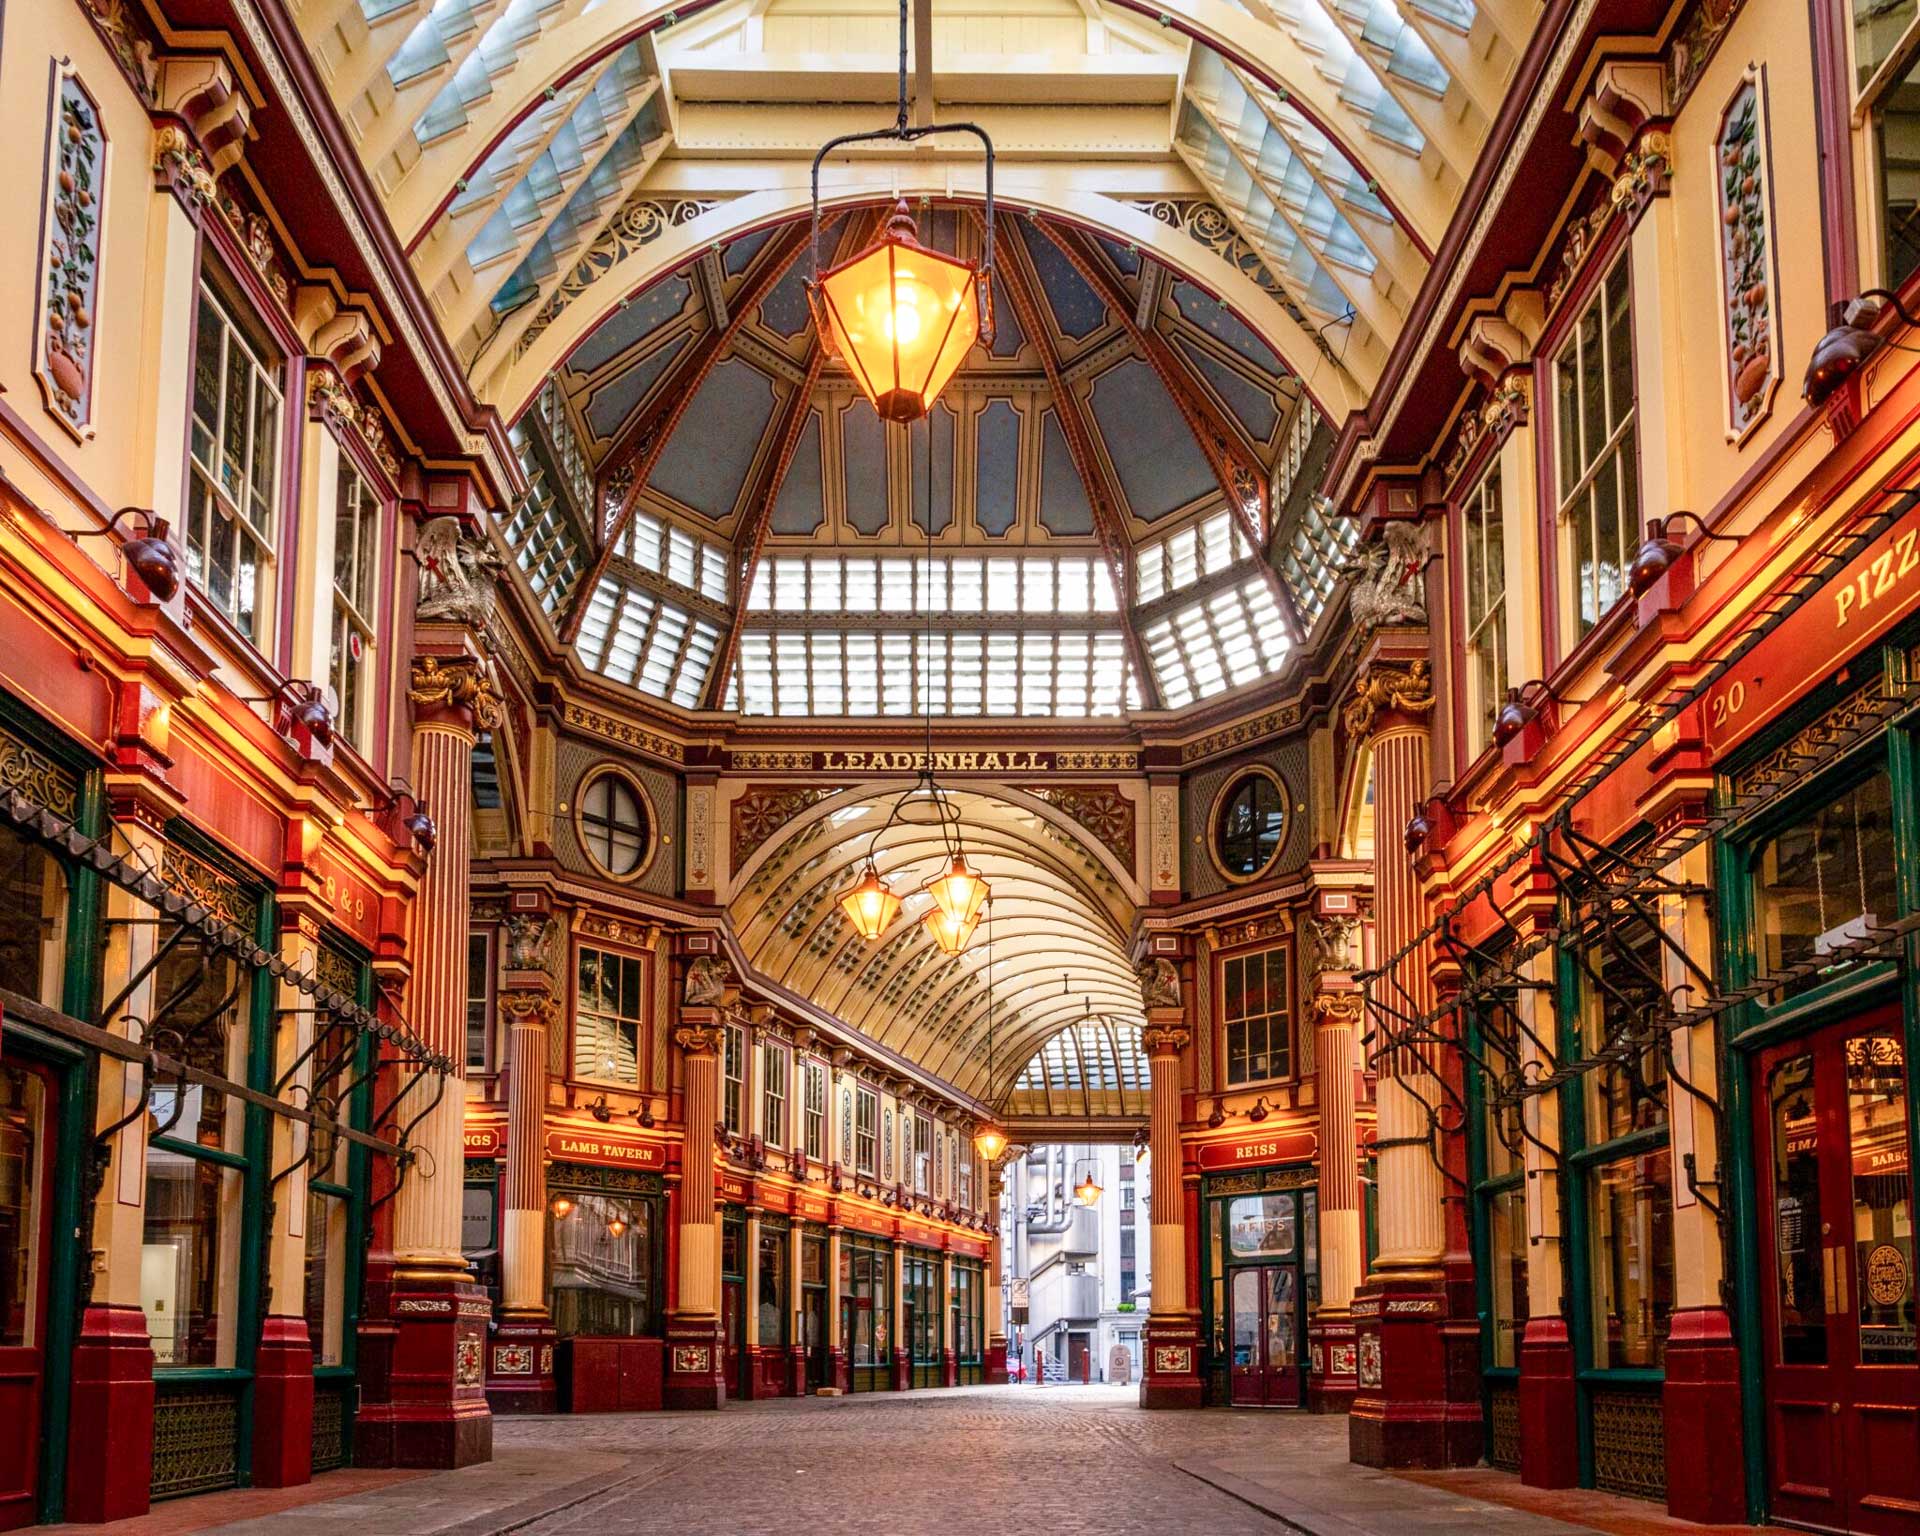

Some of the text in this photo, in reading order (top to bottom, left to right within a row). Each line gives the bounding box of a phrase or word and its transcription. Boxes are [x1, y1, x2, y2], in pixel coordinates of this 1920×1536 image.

[1712, 680, 1746, 729] 20
[823, 752, 1048, 770] LEADENHALL
[326, 875, 365, 922] 8 & 9
[560, 1139, 653, 1161] LAMB TAVERN
[1236, 1144, 1277, 1158] REISS
[1238, 1220, 1285, 1232] REISS
